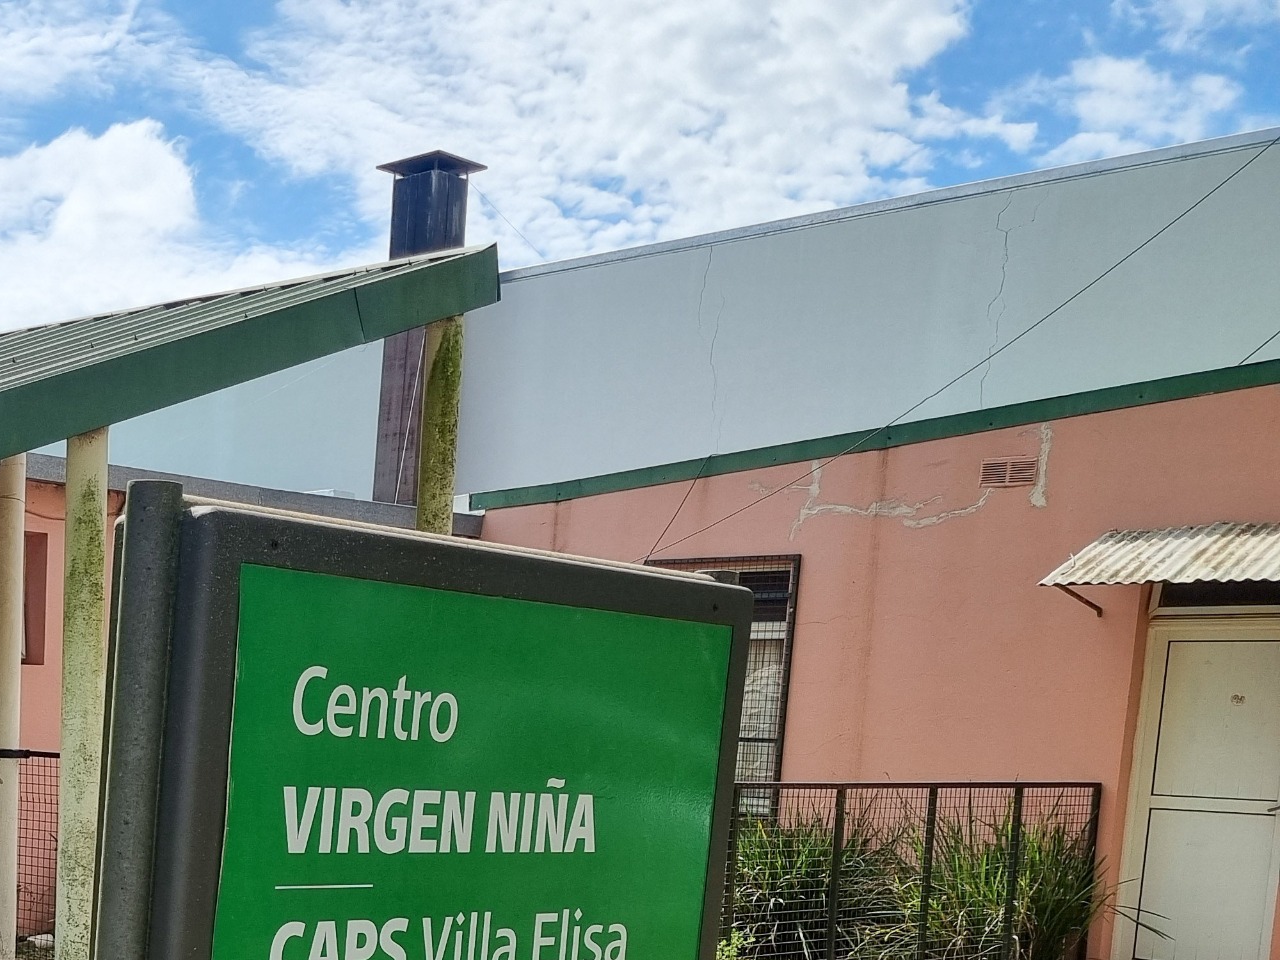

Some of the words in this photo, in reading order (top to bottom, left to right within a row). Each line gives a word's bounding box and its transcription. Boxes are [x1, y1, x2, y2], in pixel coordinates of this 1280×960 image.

[293, 666, 459, 743] Centro
[283, 786, 477, 855] VIRGEN
[485, 778, 596, 853] NIÑA
